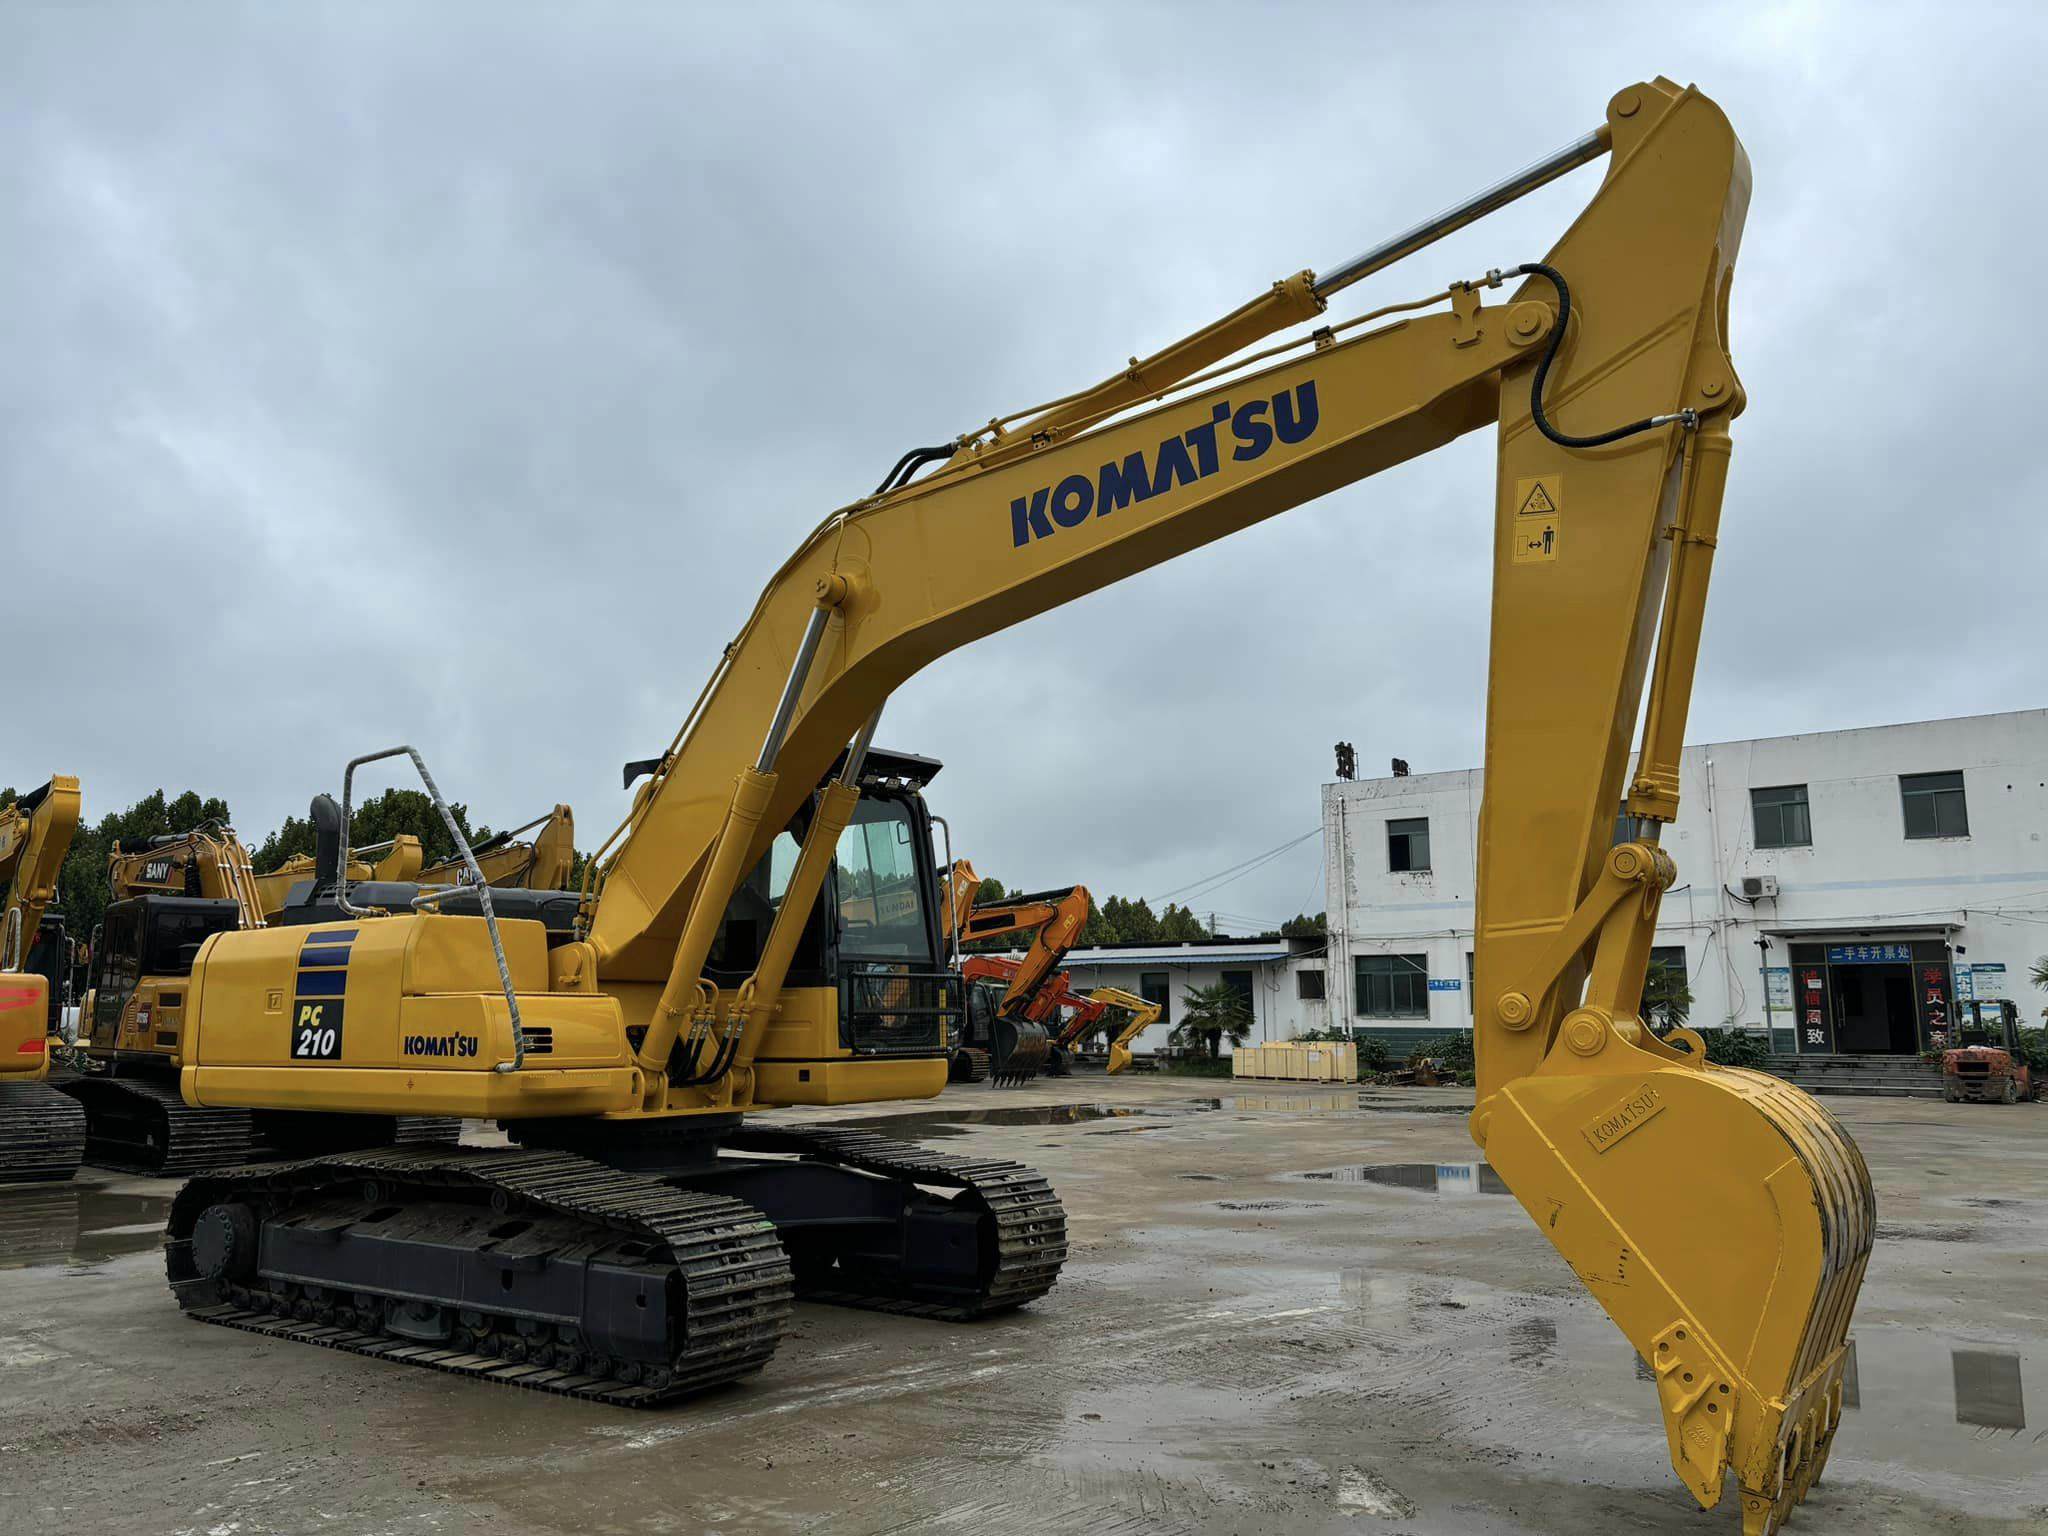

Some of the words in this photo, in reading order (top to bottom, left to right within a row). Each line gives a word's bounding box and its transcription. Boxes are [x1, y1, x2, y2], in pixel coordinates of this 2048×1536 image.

[1010, 379, 1320, 548] KOMATSU
[146, 862, 169, 879] SANY
[1831, 944, 1910, 960] 二手车开票处
[298, 1005, 323, 1026] PC
[1923, 967, 1947, 1048] 学员之家
[296, 1028, 336, 1056] 210
[404, 1031, 479, 1057] KOMATSU
[1593, 1094, 1654, 1143] KOMATSU
